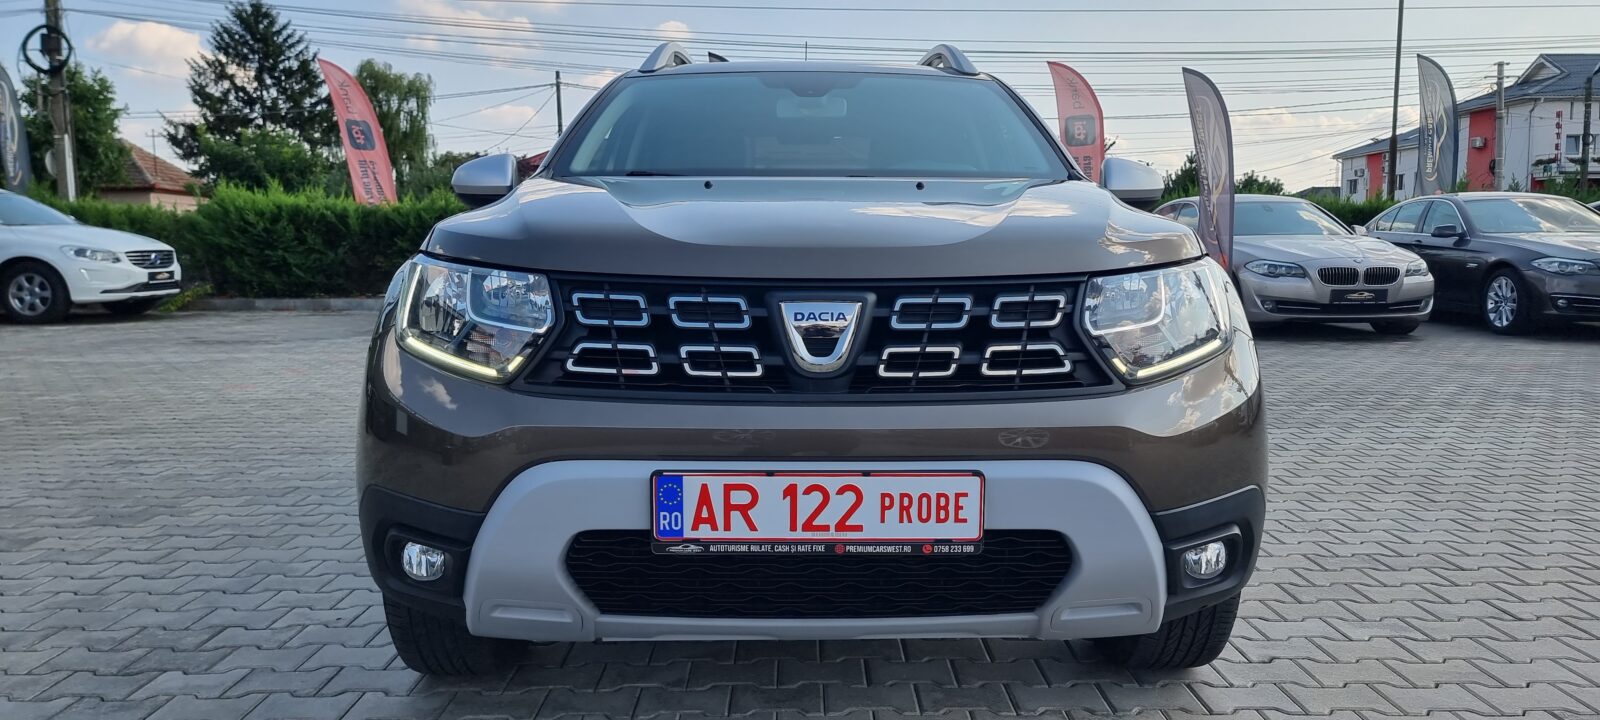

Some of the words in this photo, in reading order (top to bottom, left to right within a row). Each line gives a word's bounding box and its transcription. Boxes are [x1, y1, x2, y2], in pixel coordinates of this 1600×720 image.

[793, 312, 847, 321] DACIA
[690, 483, 760, 532] AR
[782, 483, 864, 533] 122
[879, 492, 969, 524] PROBE
[659, 511, 682, 531] RO
[709, 544, 750, 552] AUTOTURISME
[750, 544, 774, 553] RULATE,
[774, 544, 790, 552] CASH
[798, 544, 812, 552] RATE
[812, 544, 825, 552] FIXE
[846, 545, 912, 553] PREMIUMCARSWEST.RO
[933, 545, 950, 553] 0758
[950, 545, 962, 553] 233
